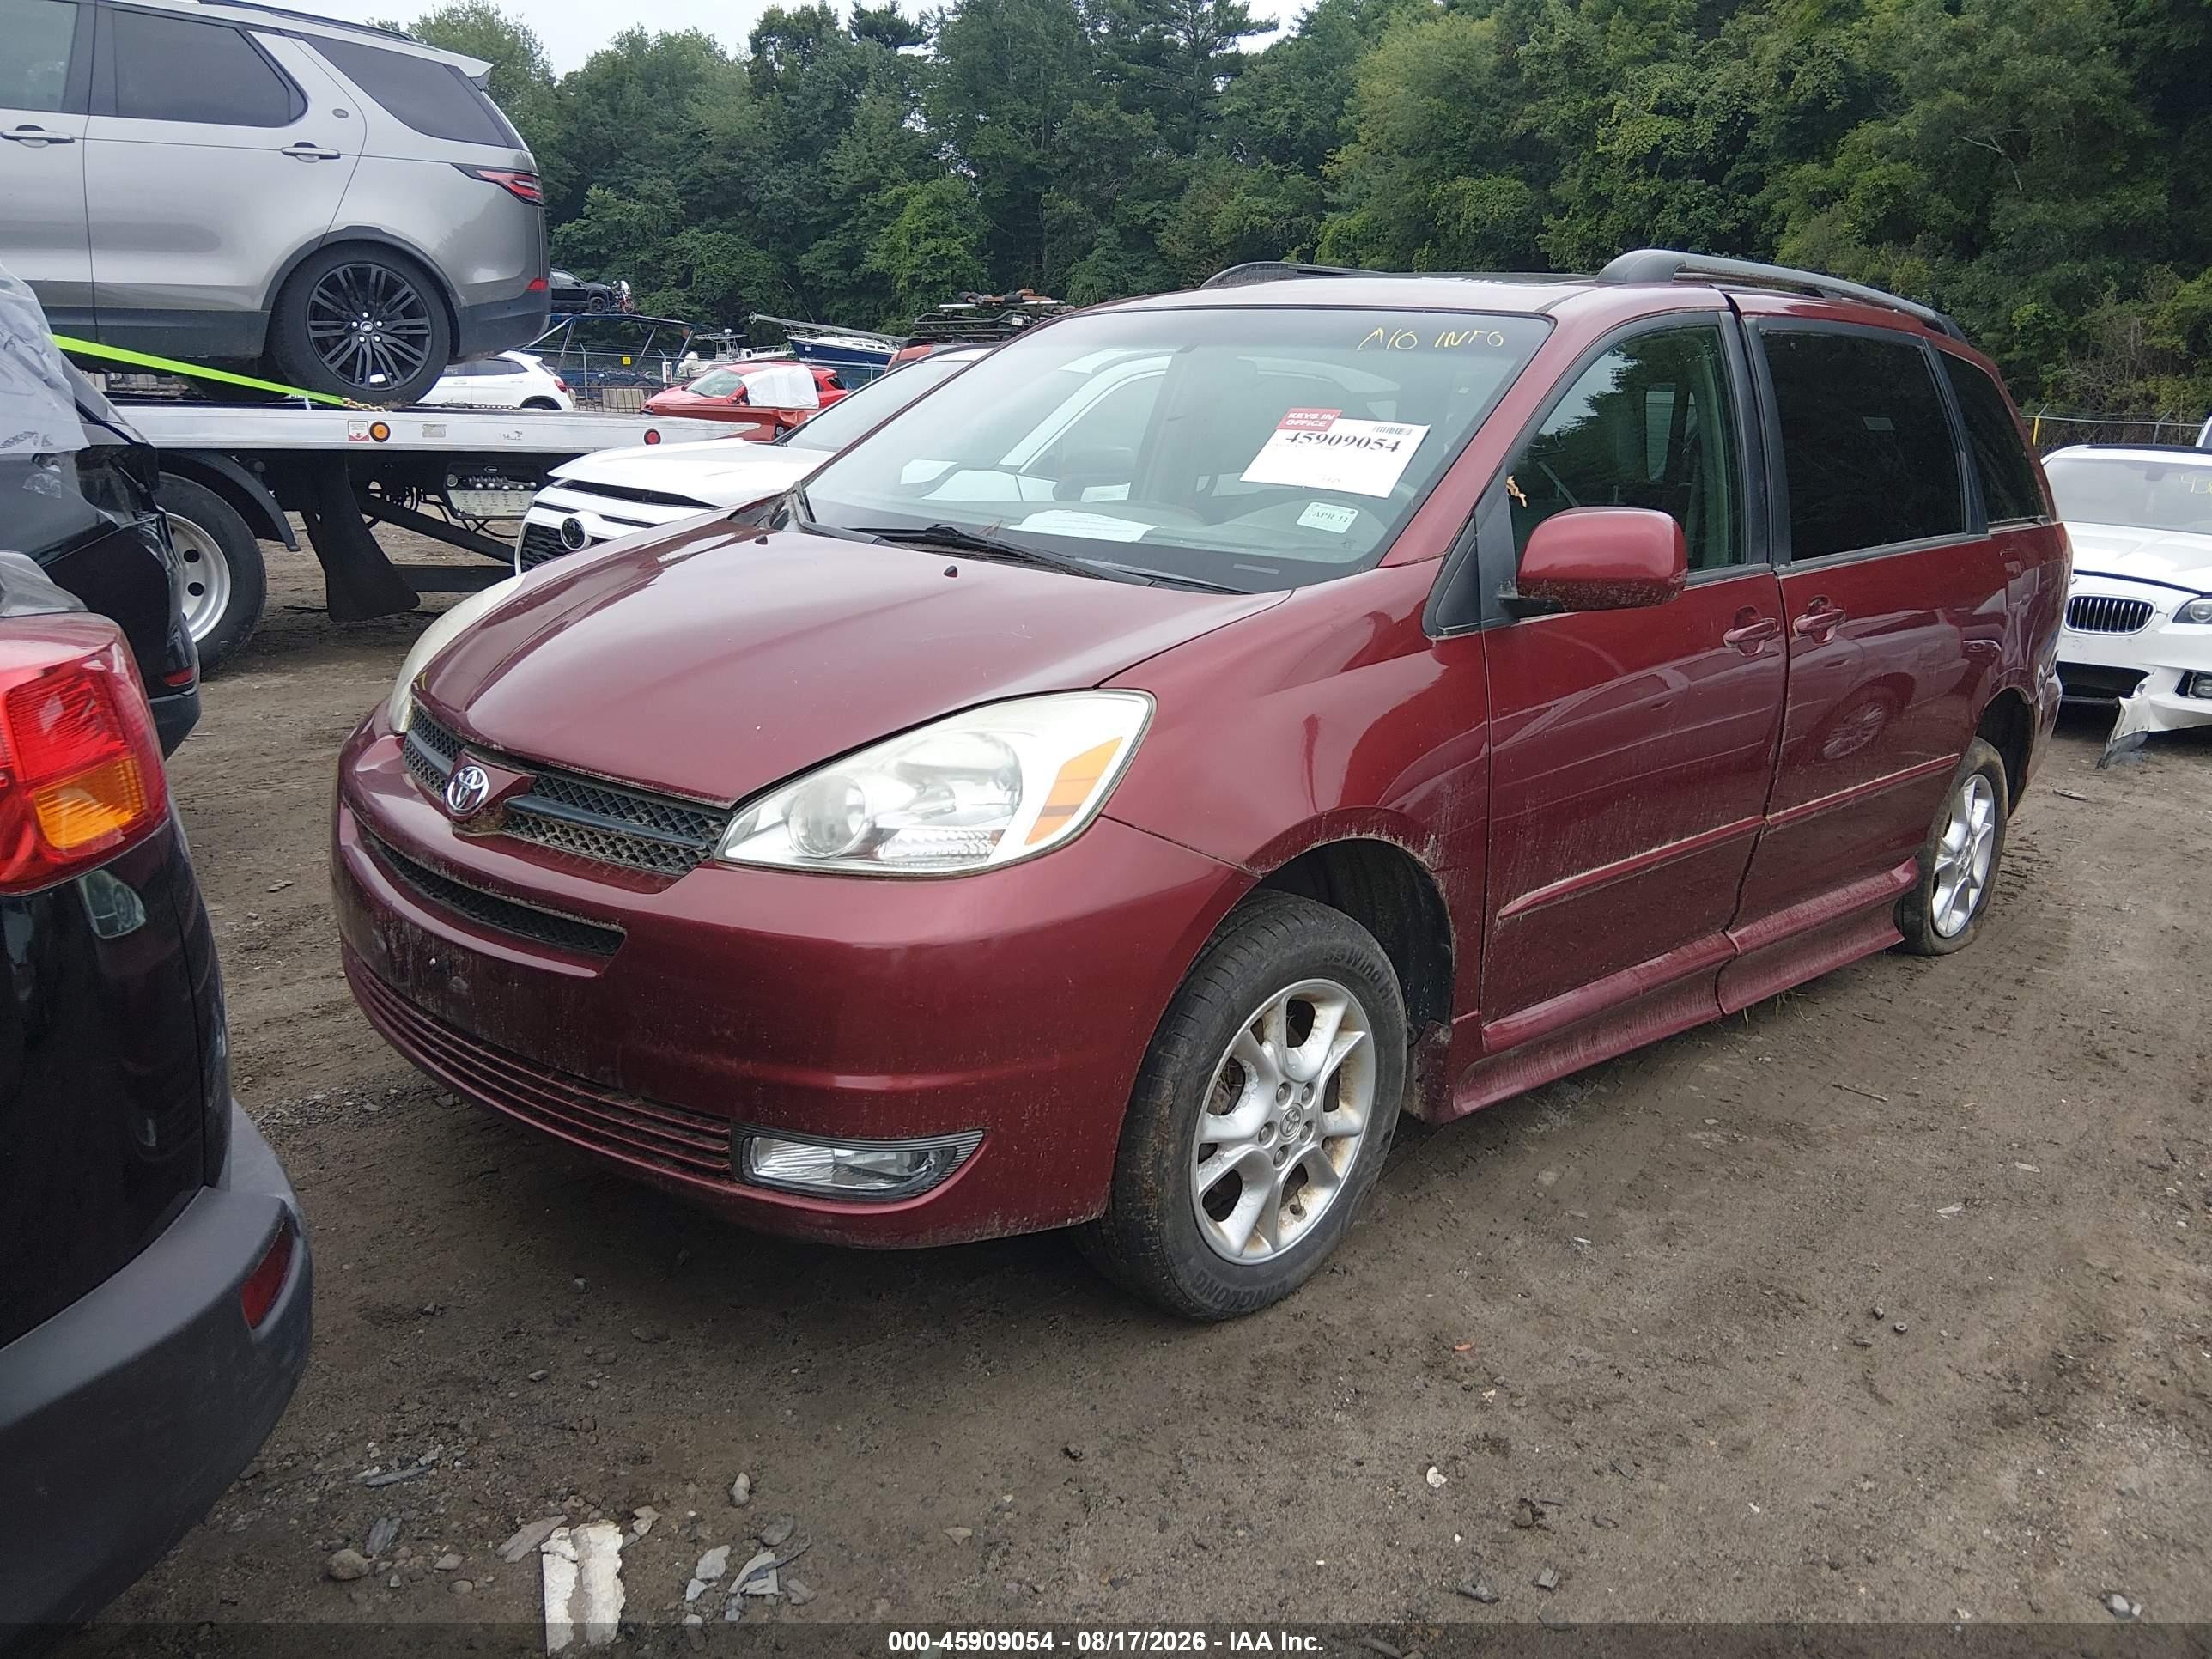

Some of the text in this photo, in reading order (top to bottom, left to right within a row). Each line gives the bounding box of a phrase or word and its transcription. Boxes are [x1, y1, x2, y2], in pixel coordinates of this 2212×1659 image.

[1434, 329, 1504, 348] INFO
[1285, 431, 1401, 453] 45909054
[1312, 511, 1335, 520] APR
